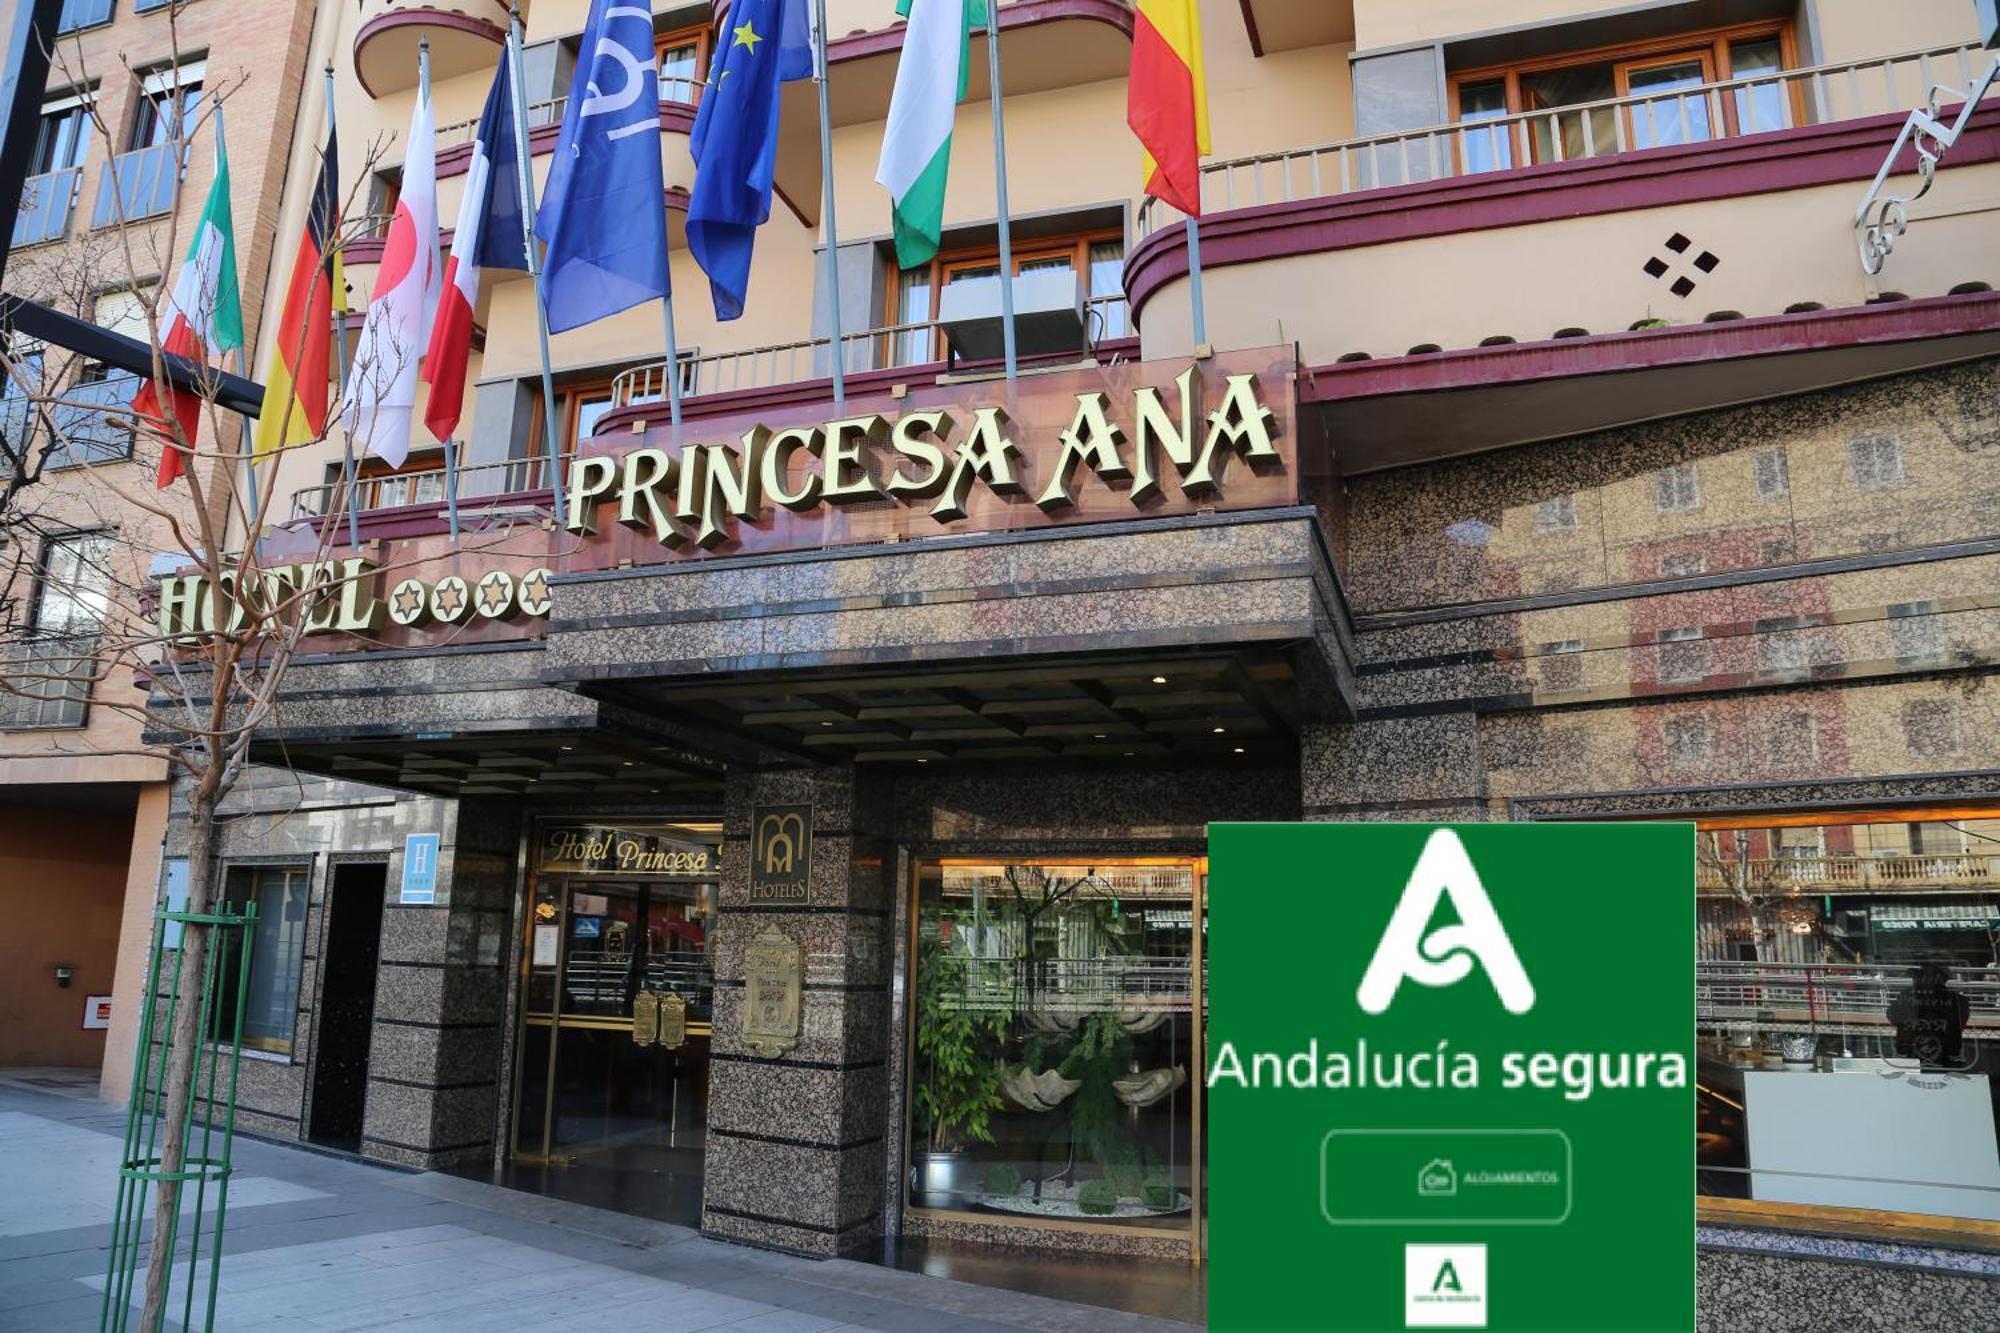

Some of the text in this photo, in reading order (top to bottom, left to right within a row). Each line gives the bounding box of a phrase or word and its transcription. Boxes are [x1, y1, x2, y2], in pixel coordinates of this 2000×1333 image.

[564, 364, 1284, 548] PRINCESA ANA
[158, 556, 387, 643] HOTEL
[412, 842, 430, 874] H
[551, 831, 613, 862] Hotel
[616, 840, 708, 871] Princesa
[752, 880, 806, 898] HOTELES
